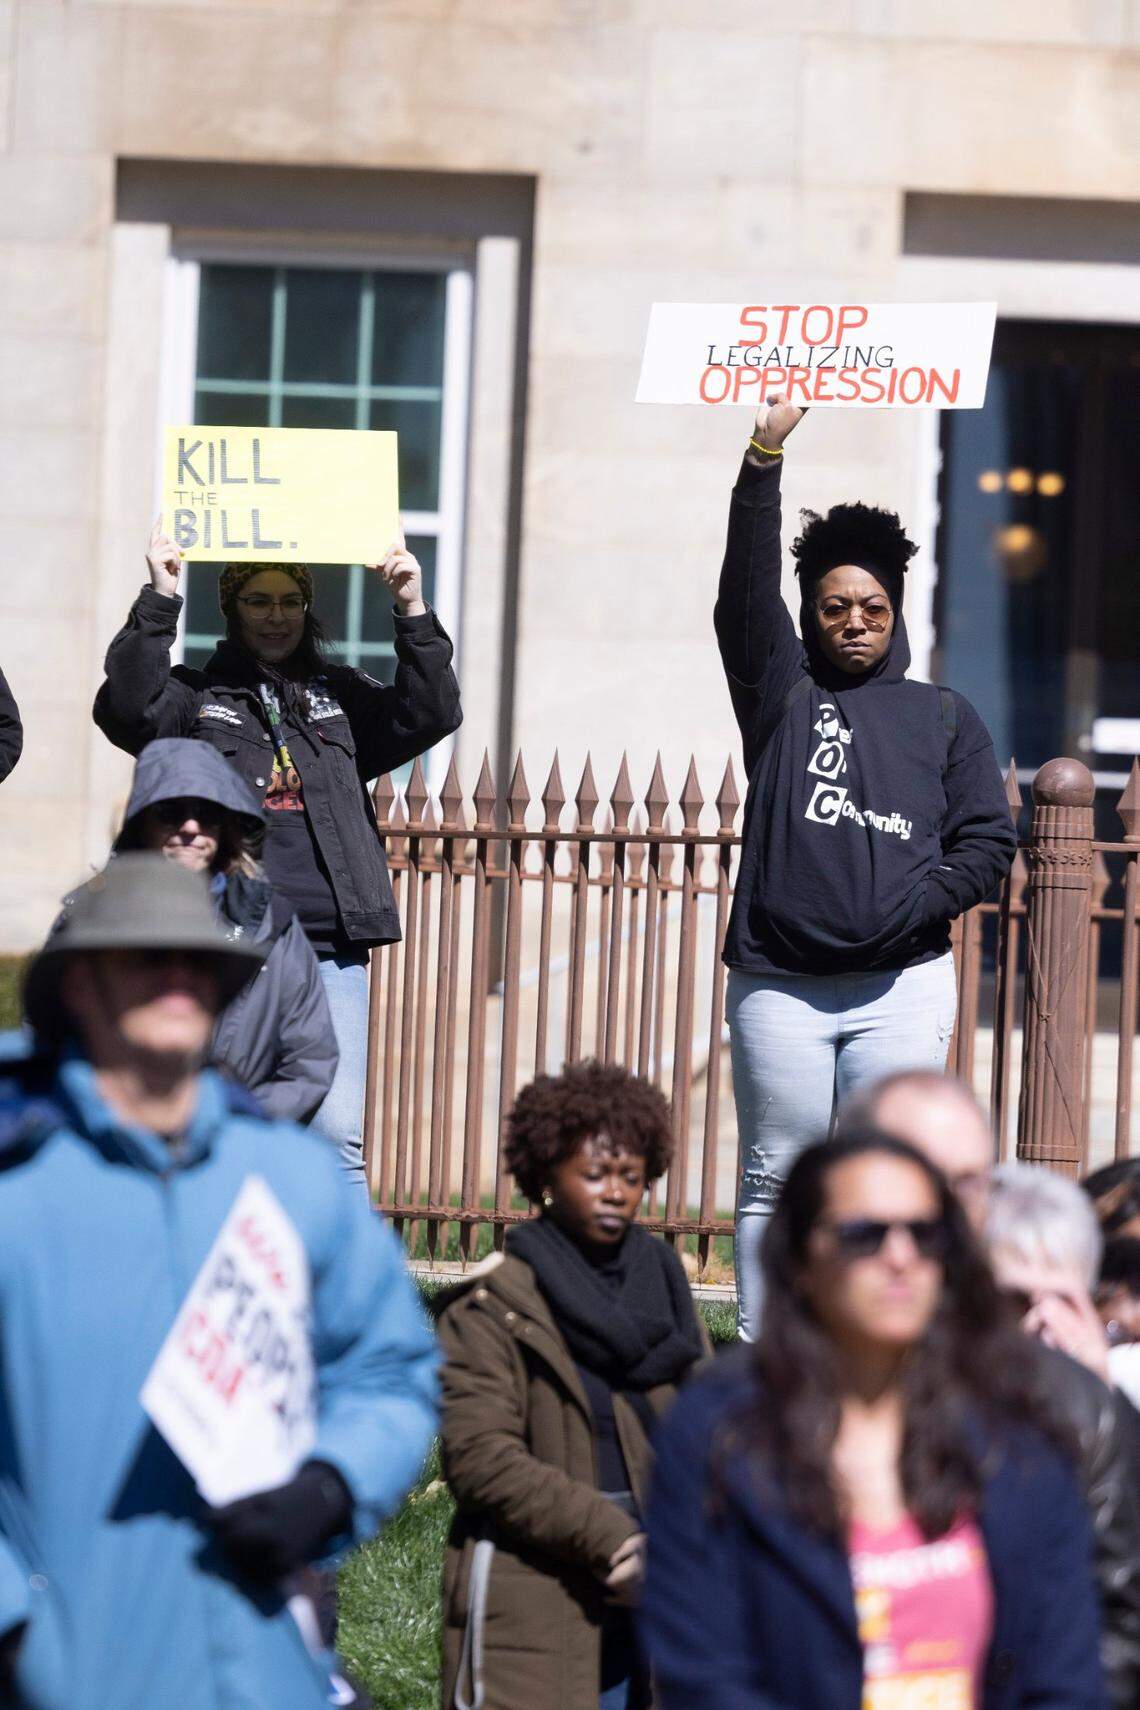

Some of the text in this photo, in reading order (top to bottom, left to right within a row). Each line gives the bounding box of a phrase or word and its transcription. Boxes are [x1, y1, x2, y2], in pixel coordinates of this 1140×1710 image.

[738, 305, 868, 347] STOP
[706, 345, 895, 368] LEGALIZING
[699, 365, 961, 405] OPPRESSION
[177, 438, 281, 487] KILL
[173, 490, 218, 506] THE
[174, 508, 298, 550] BILL.
